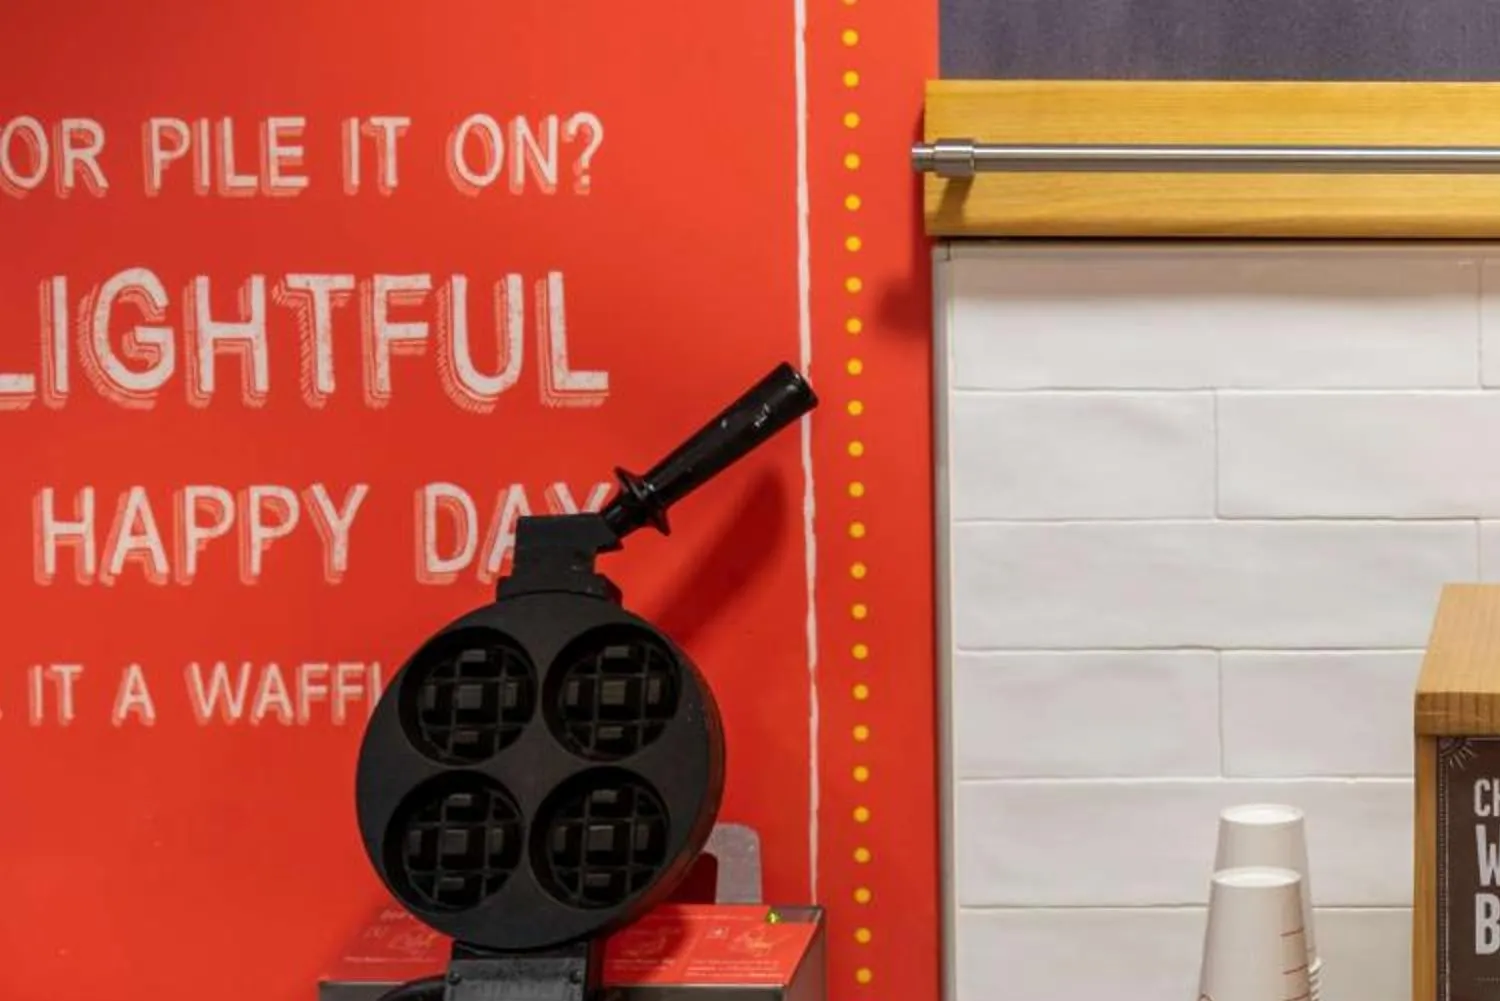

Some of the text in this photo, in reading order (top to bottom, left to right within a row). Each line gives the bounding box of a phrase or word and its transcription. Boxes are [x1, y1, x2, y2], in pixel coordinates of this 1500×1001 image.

[0, 111, 604, 197] OR PILE IT ON?
[33, 483, 368, 586] HAPPY
[28, 663, 83, 726] IT
[112, 662, 155, 727] A
